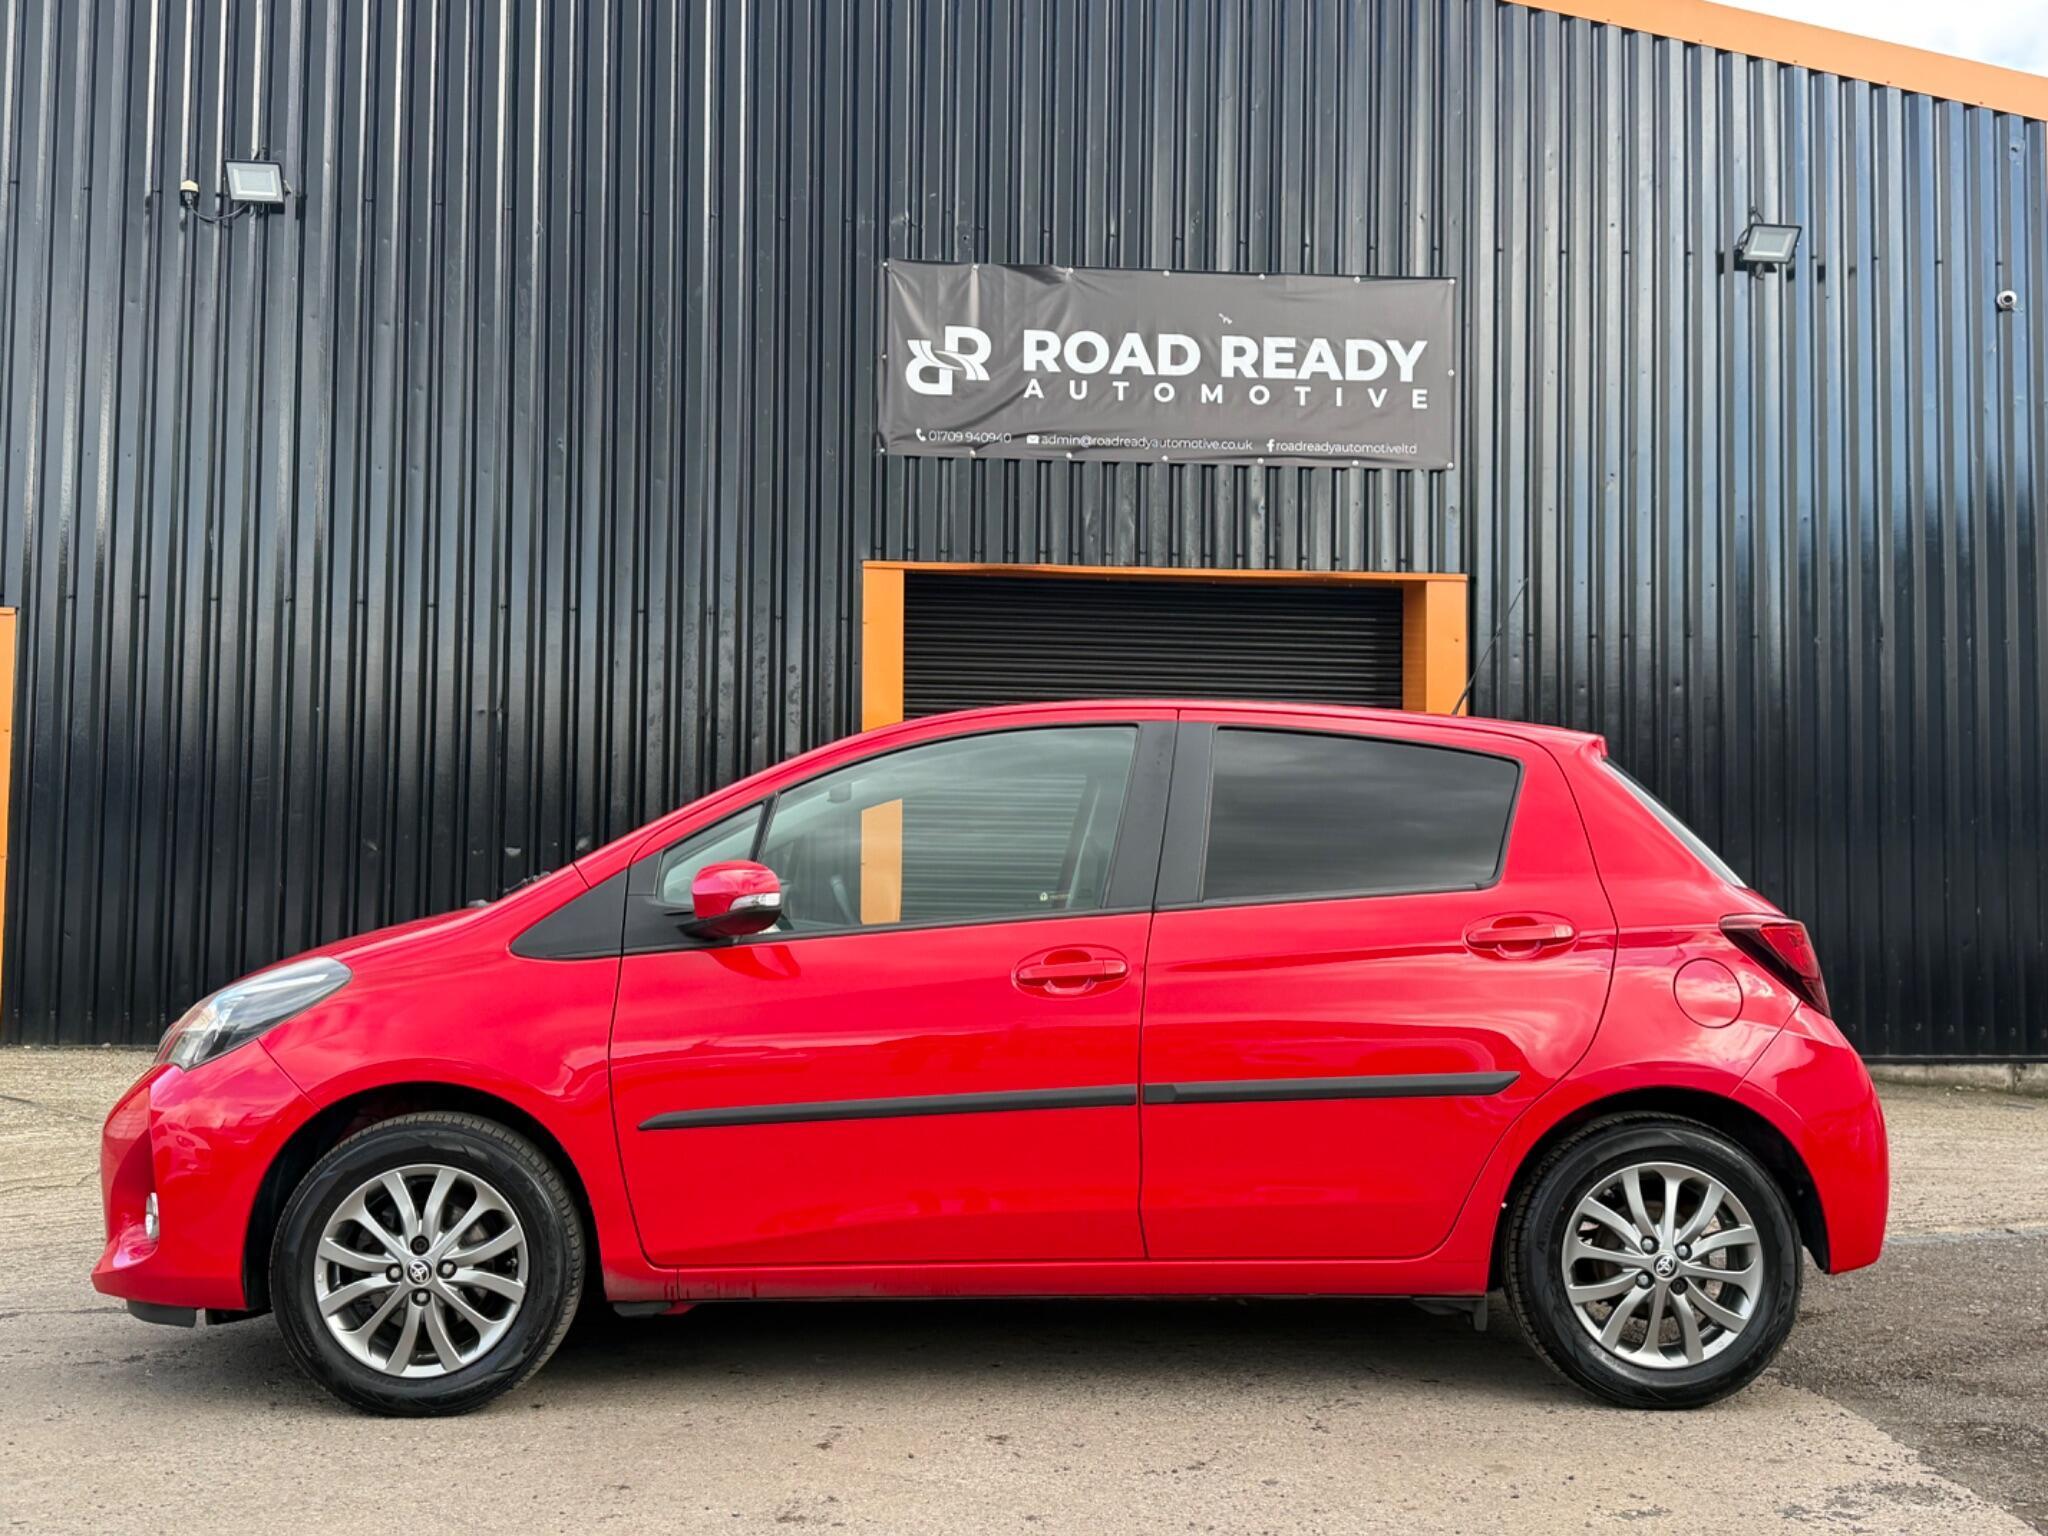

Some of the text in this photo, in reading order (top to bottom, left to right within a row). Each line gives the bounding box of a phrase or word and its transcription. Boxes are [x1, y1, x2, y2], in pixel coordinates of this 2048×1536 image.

[1024, 330, 1428, 383] ROAD READY
[1024, 379, 1428, 410] AUTOMOTIVE
[928, 431, 964, 443] 01709
[964, 431, 1012, 444] 940940
[1041, 434, 1254, 451] admin@roadreadyautomotive.co.uk
[1275, 440, 1418, 455] roadreadyautomotiveltd
